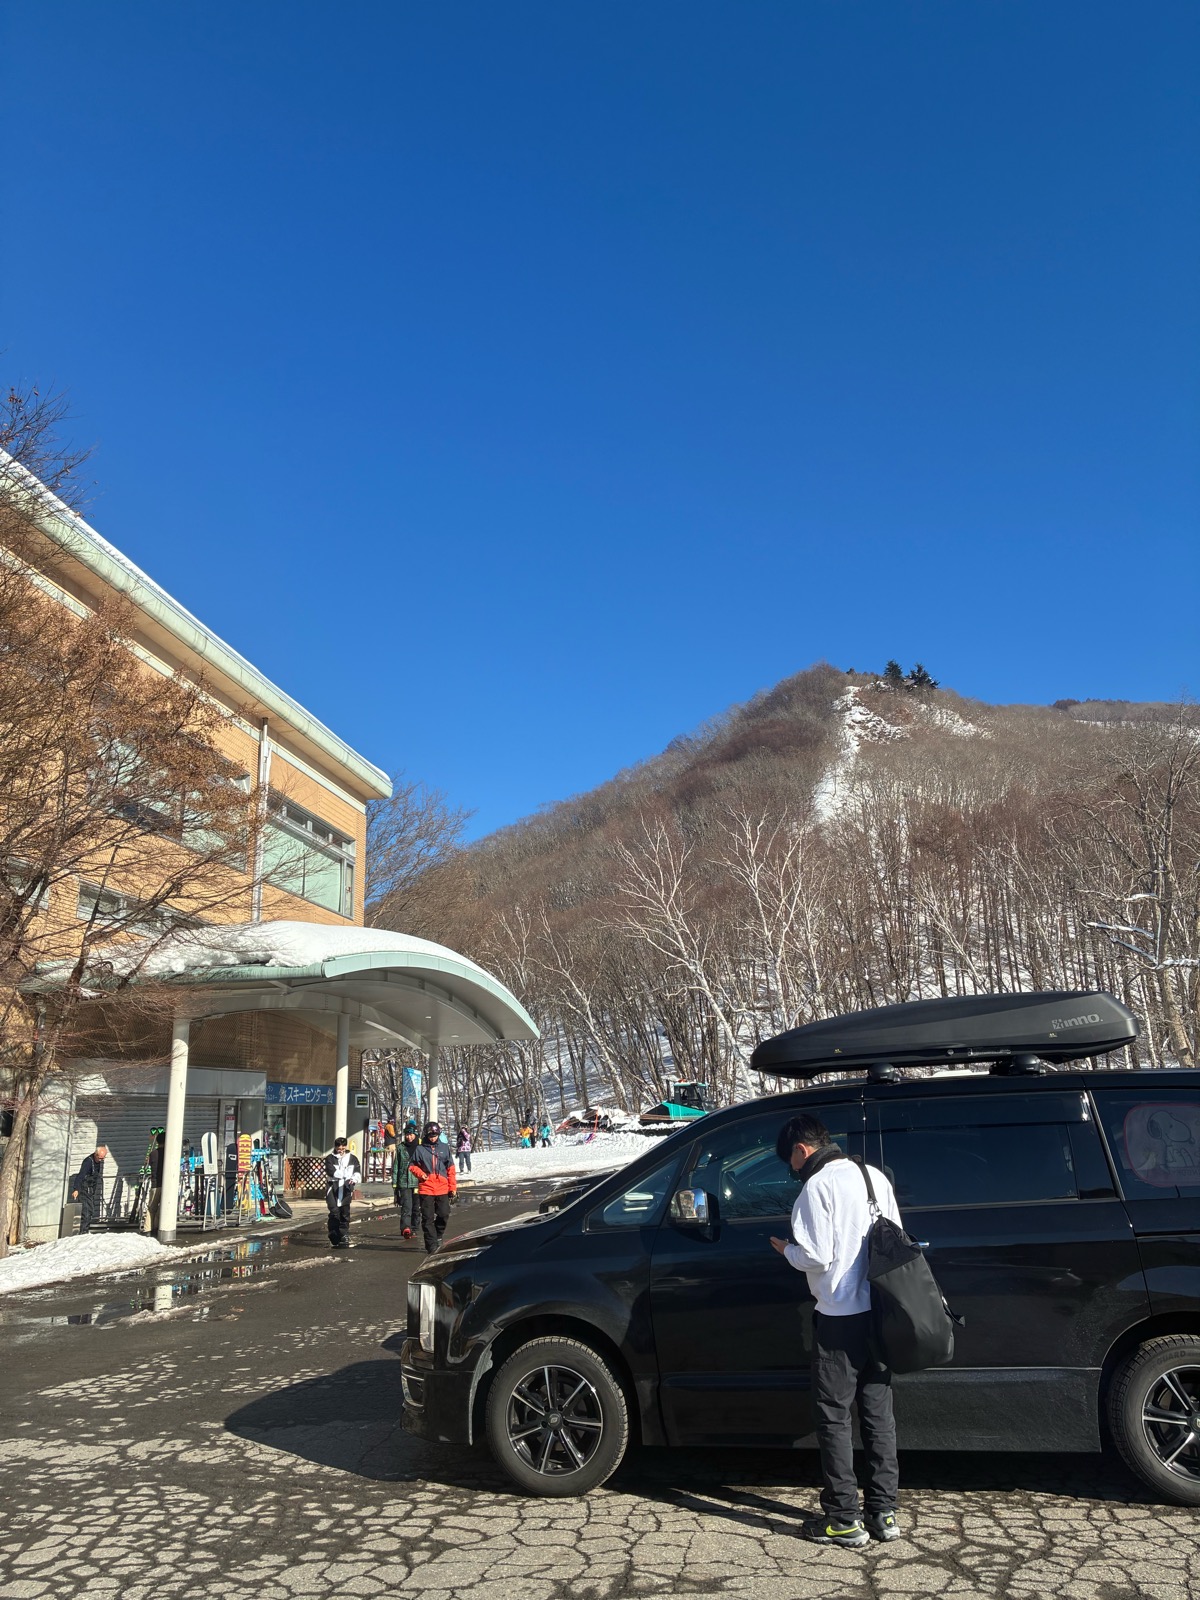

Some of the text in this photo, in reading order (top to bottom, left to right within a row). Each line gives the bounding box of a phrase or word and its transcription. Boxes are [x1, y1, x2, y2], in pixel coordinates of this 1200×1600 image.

[287, 1087, 326, 1103] スキーセンター
